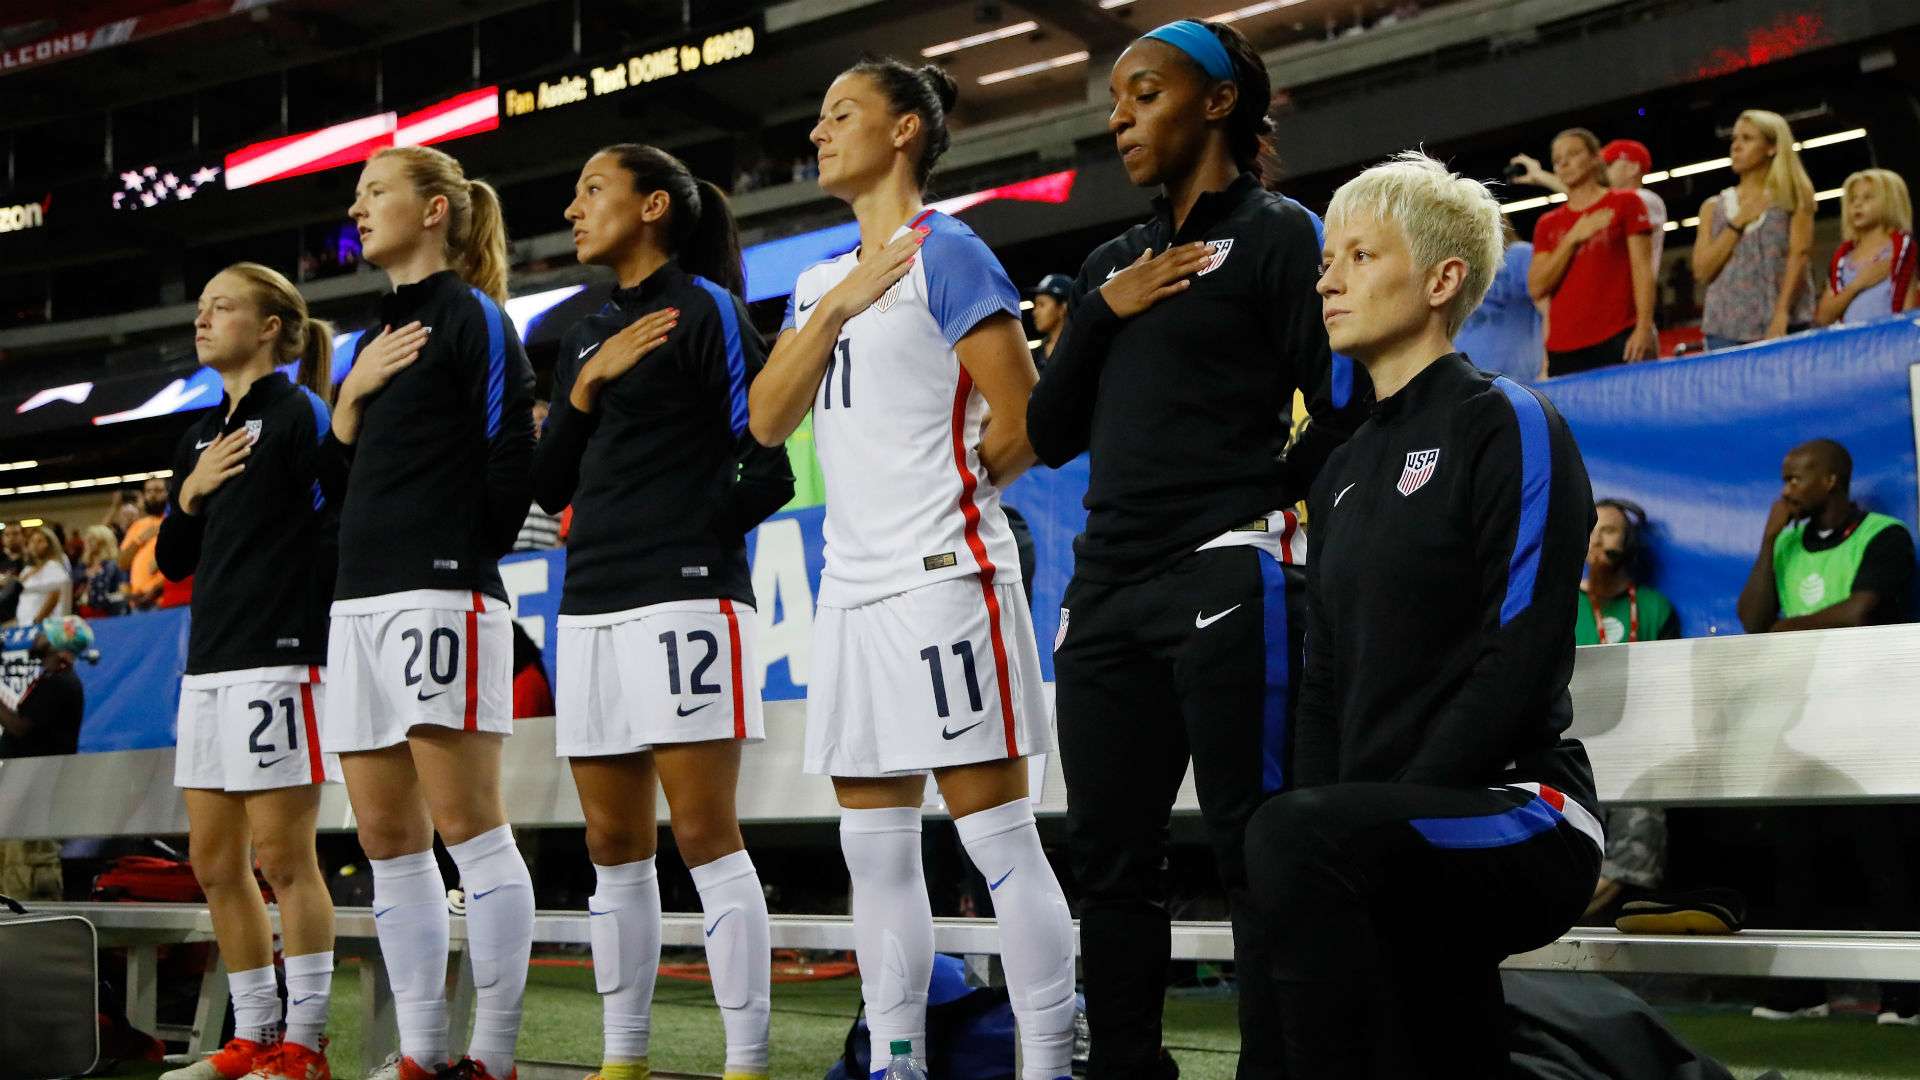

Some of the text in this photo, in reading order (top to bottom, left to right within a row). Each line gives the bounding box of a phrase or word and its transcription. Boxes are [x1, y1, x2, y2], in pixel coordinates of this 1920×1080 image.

[0, 32, 87, 68] LCONS
[505, 89, 535, 117] Fan
[590, 63, 627, 96] Text
[628, 47, 679, 87] DOME
[680, 45, 700, 72] to
[1407, 450, 1438, 471] USA
[401, 627, 460, 687] 20
[658, 629, 722, 695] 12
[919, 640, 984, 718] 11
[247, 697, 298, 753] 21
